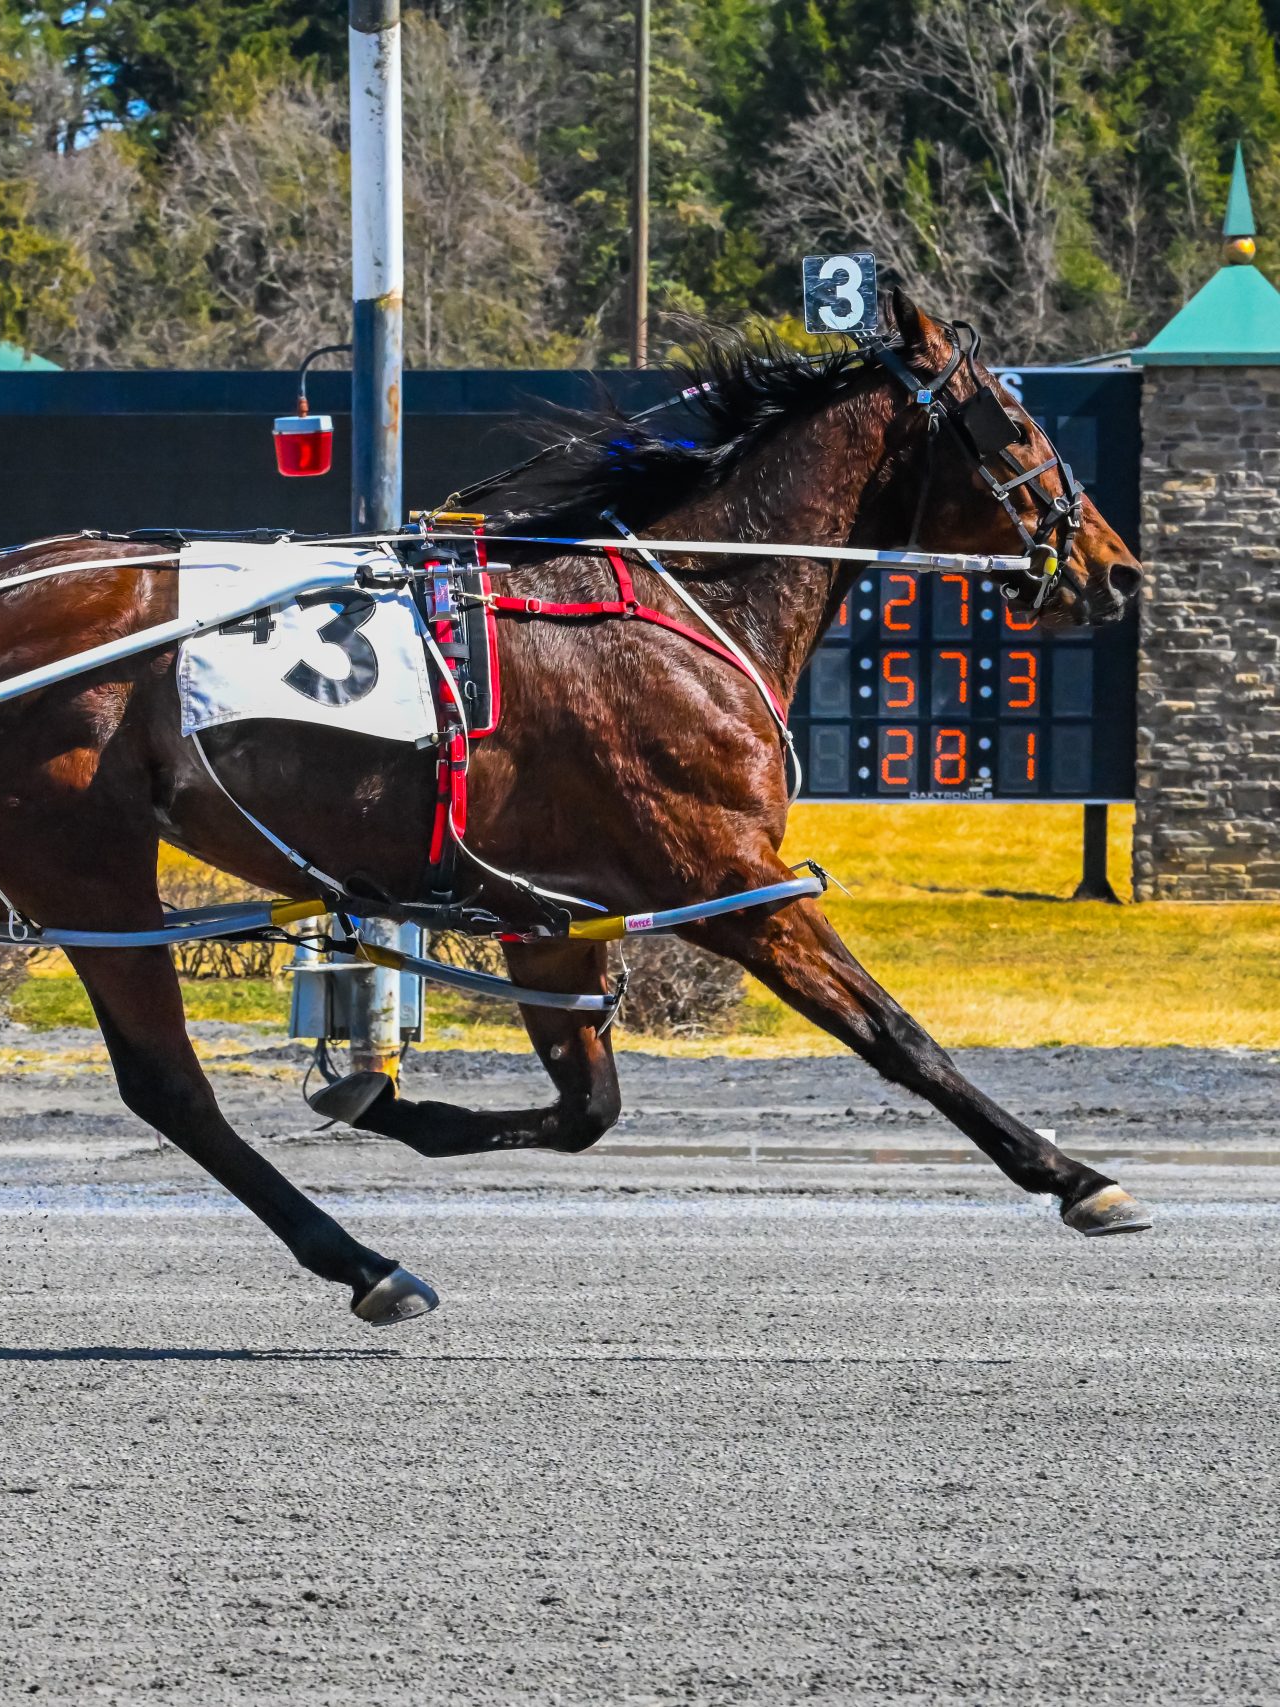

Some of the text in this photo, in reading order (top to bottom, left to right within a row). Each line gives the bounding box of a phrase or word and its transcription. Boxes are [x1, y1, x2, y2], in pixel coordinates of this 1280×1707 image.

[819, 256, 864, 330] 3
[282, 587, 379, 708] 3
[908, 791, 994, 800] DAKTRONICS
